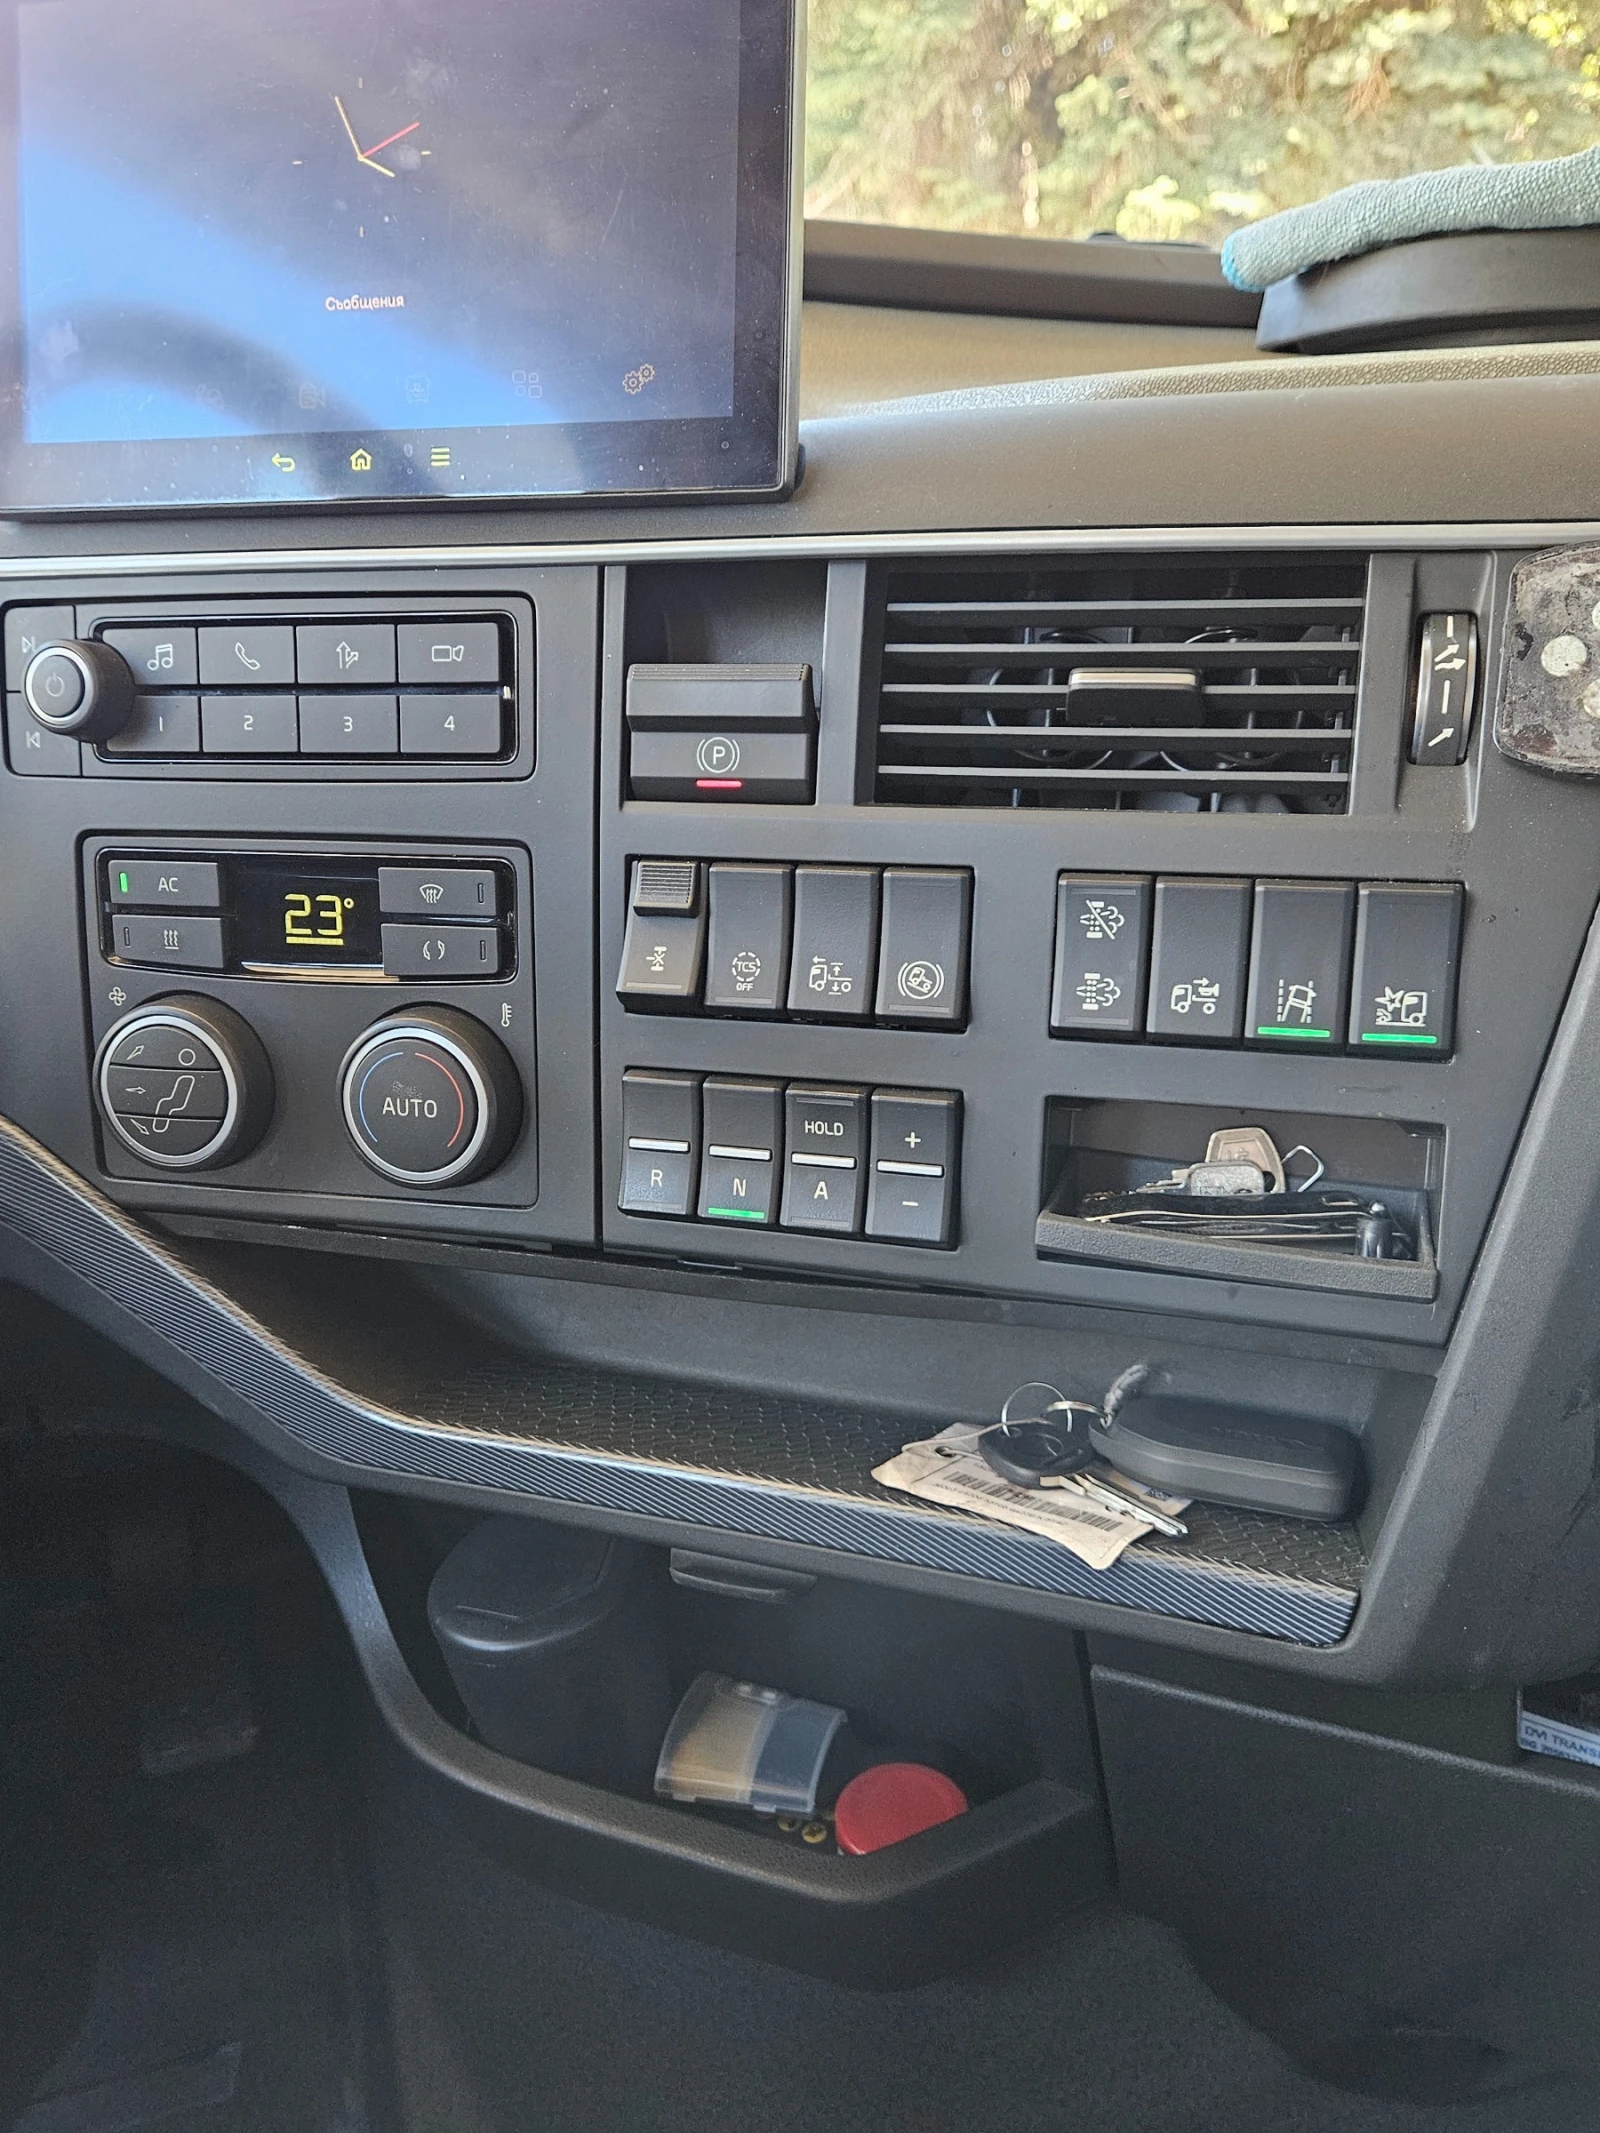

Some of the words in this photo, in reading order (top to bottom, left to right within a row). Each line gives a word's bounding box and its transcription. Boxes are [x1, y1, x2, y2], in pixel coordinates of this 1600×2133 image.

[325, 295, 404, 311] Съобщения
[243, 715, 254, 731] 2
[343, 716, 353, 732] 3
[443, 715, 456, 731] 4
[712, 746, 726, 765] P
[157, 877, 179, 892] AC
[736, 961, 756, 972] TCS
[736, 982, 754, 991] OFF
[382, 1096, 438, 1119] AUTO
[804, 1120, 844, 1136] HOLD
[651, 1169, 663, 1188] R
[733, 1178, 747, 1197] N
[813, 1181, 829, 1200] A
